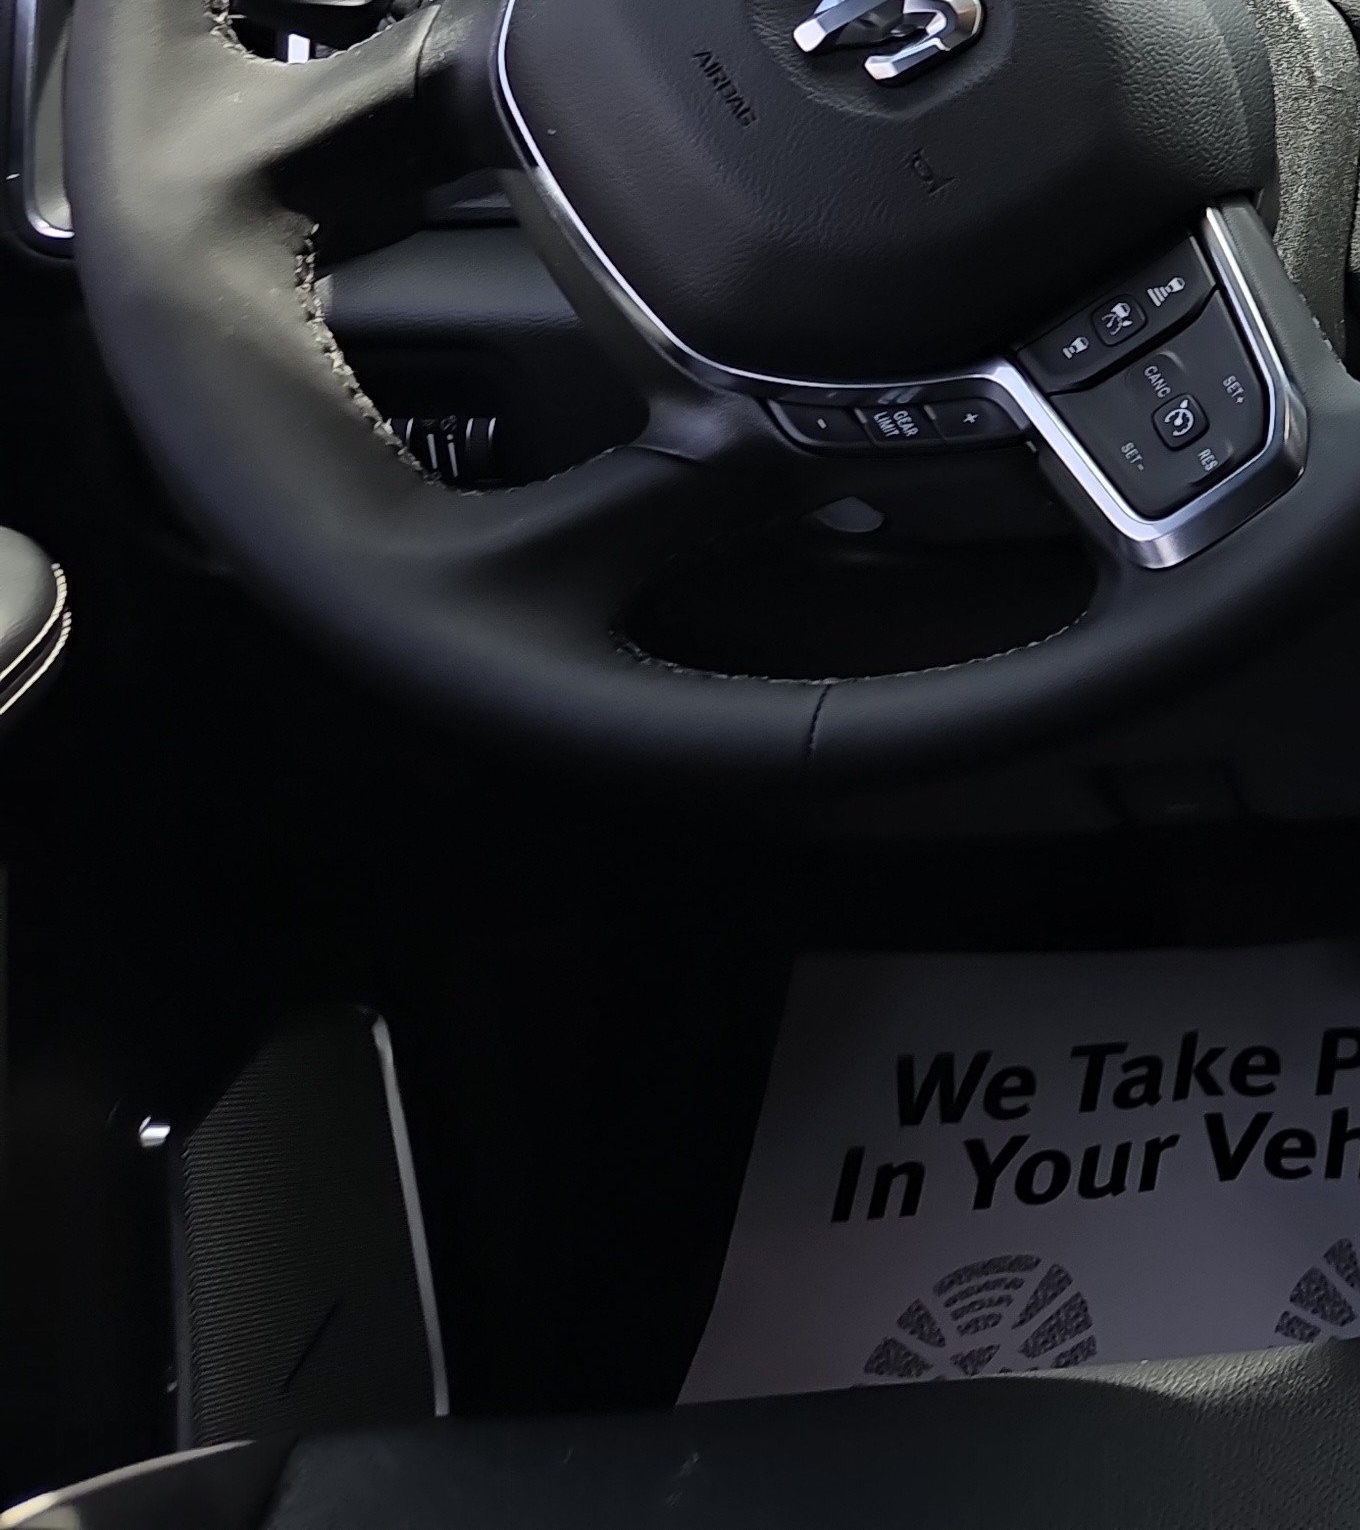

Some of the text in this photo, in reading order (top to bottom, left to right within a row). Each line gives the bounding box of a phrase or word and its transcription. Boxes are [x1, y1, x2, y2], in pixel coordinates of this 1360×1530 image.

[1144, 365, 1171, 399] CANC
[874, 410, 900, 439] LIMIT
[894, 409, 920, 439] GEAR
[1198, 448, 1218, 471] RES
[895, 1049, 1037, 1128] We
[1070, 1032, 1282, 1115] Take
[830, 1146, 926, 1223] In
[962, 1133, 1180, 1212] Your
